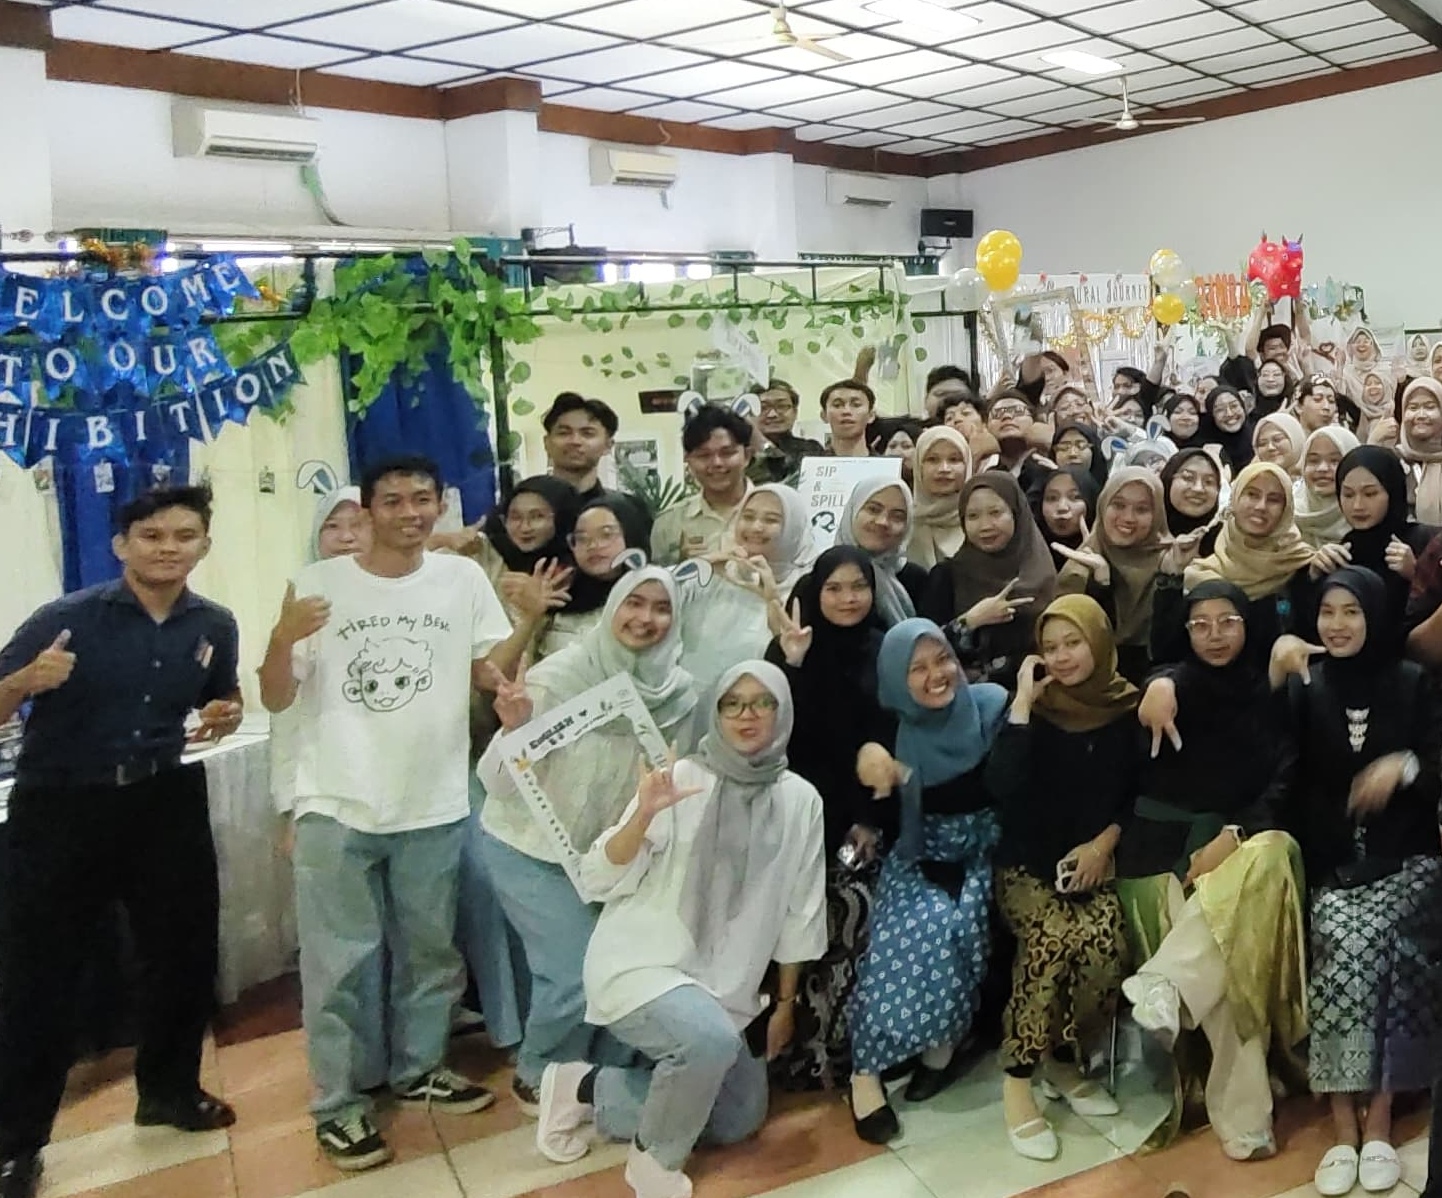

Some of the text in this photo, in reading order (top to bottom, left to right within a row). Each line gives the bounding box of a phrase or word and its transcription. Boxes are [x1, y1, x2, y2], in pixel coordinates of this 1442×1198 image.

[14, 261, 240, 324] ELCOME
[0, 337, 217, 388] TO OUR
[0, 351, 293, 451] HIBITION
[816, 465, 837, 478] SIP
[810, 494, 846, 507] SPILL
